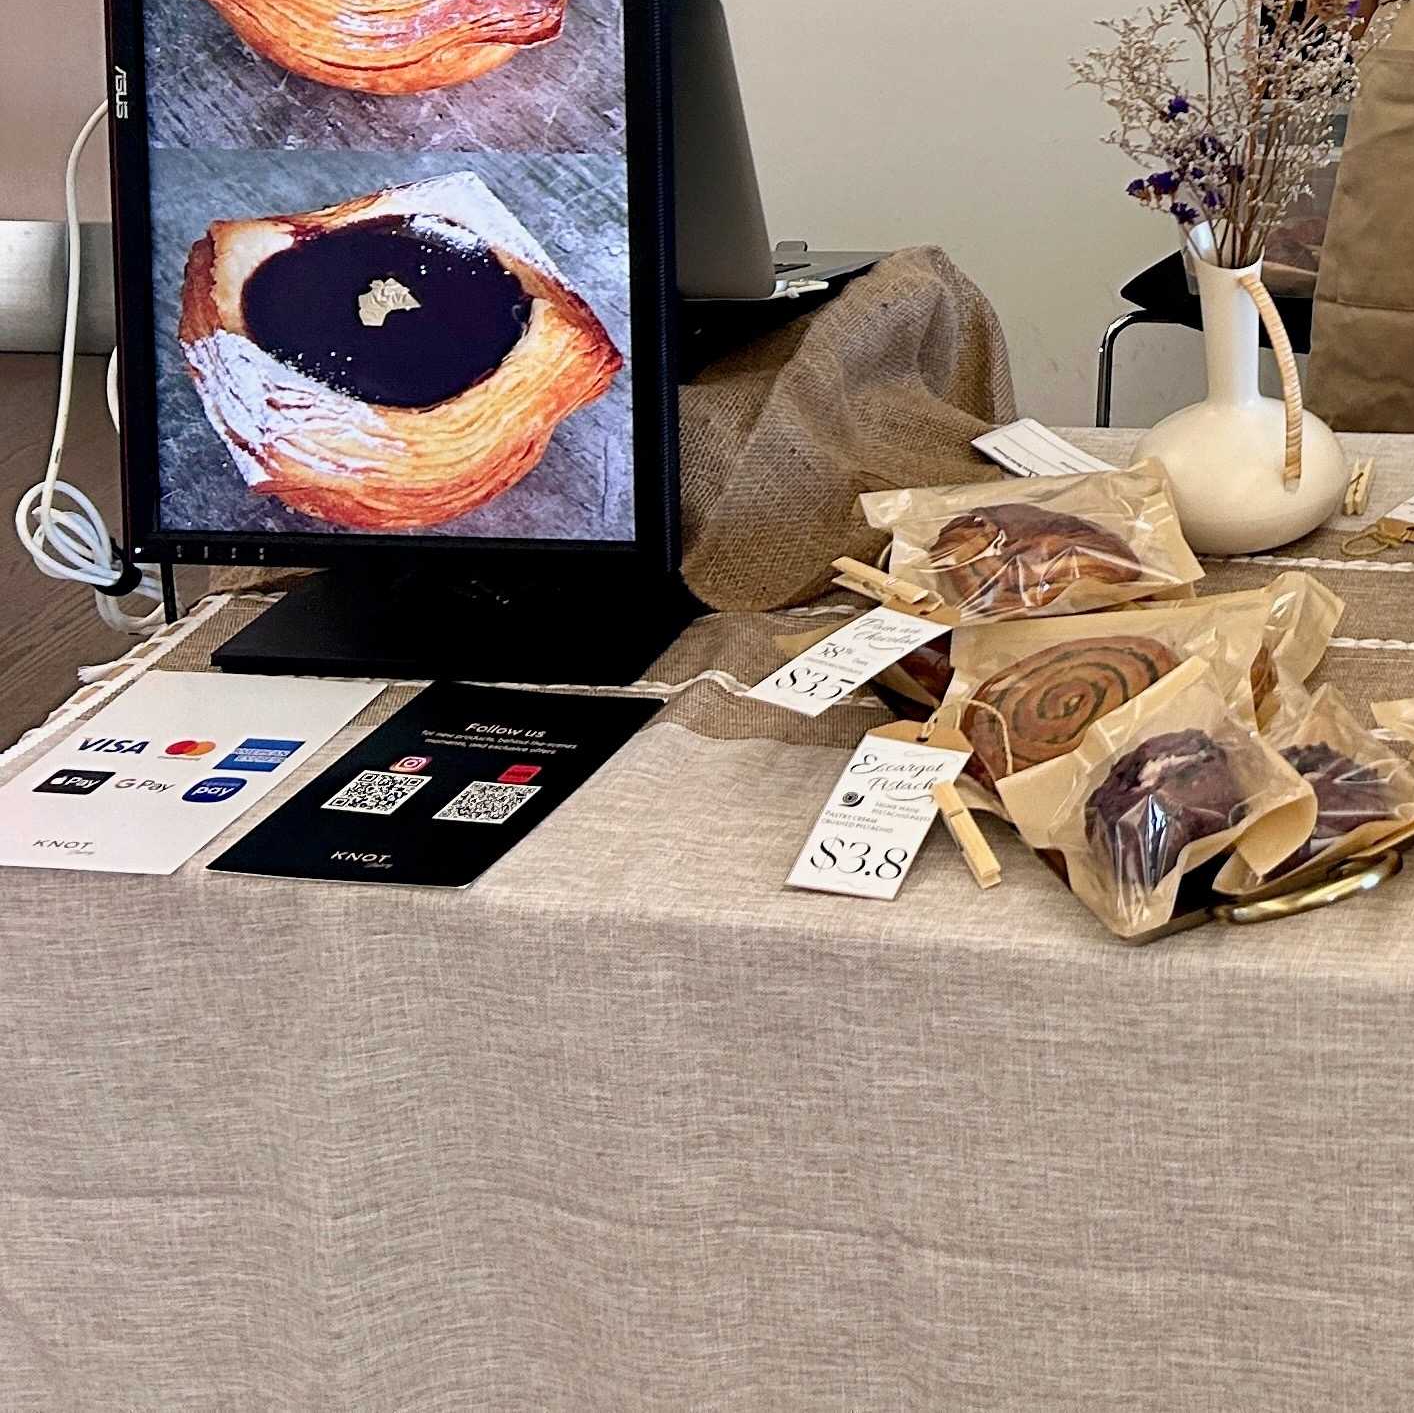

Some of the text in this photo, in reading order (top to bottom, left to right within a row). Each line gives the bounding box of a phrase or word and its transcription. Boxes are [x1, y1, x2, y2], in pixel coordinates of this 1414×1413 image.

[115, 65, 129, 119] ASUS
[775, 666, 856, 700] $3.5
[464, 722, 547, 738] Follow us
[78, 737, 151, 755] VISA
[849, 753, 946, 778] Escargot
[64, 776, 102, 789] Pay
[115, 778, 176, 793] G Pay
[867, 776, 938, 792] Pistach
[191, 786, 235, 797] pay
[32, 839, 94, 850] KNOT
[330, 850, 392, 863] KNOT
[809, 834, 909, 881] $3.8
